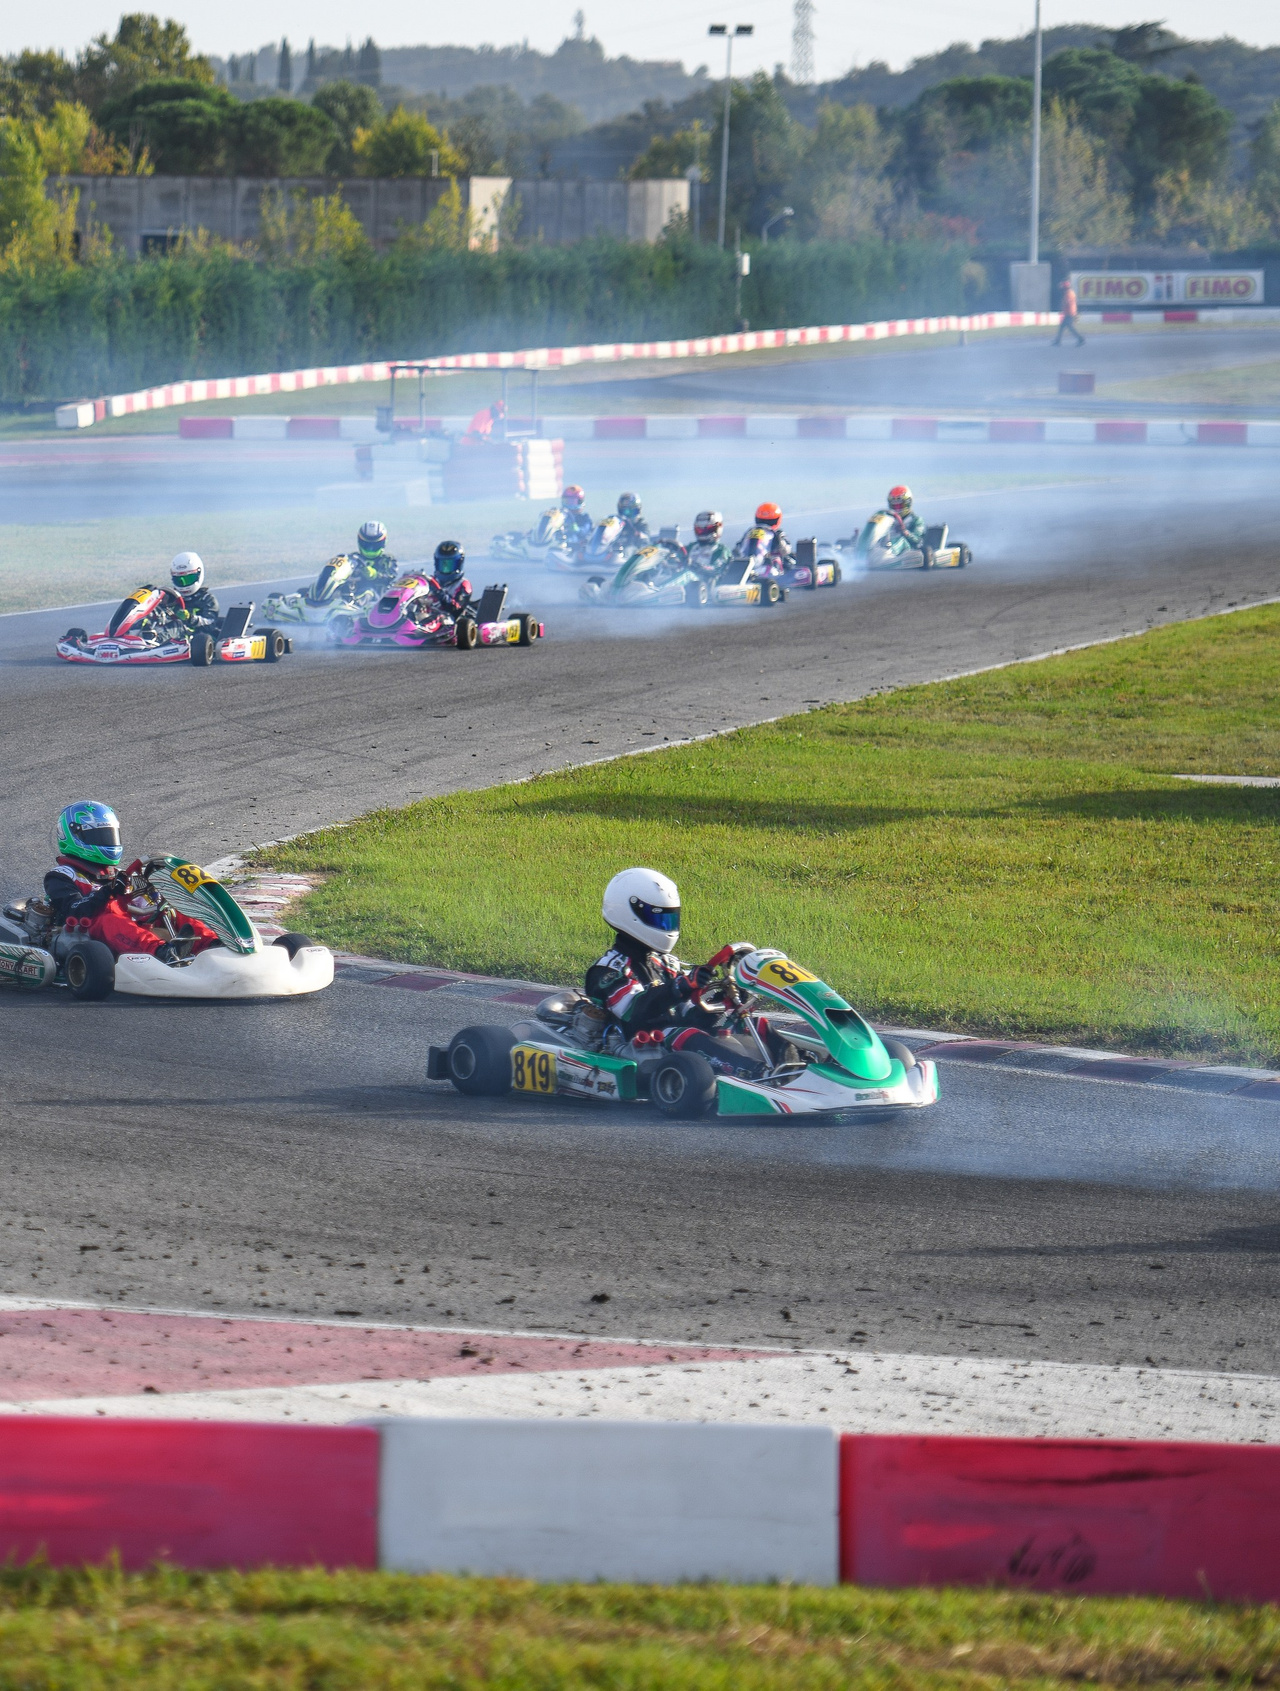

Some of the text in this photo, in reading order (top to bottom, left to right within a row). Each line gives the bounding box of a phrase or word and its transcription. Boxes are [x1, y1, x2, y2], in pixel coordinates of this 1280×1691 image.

[1082, 279, 1144, 296] FIMO
[1189, 279, 1251, 296] FIMO
[177, 865, 212, 885] 82
[770, 962, 814, 984] 81
[514, 1050, 550, 1092] 819
